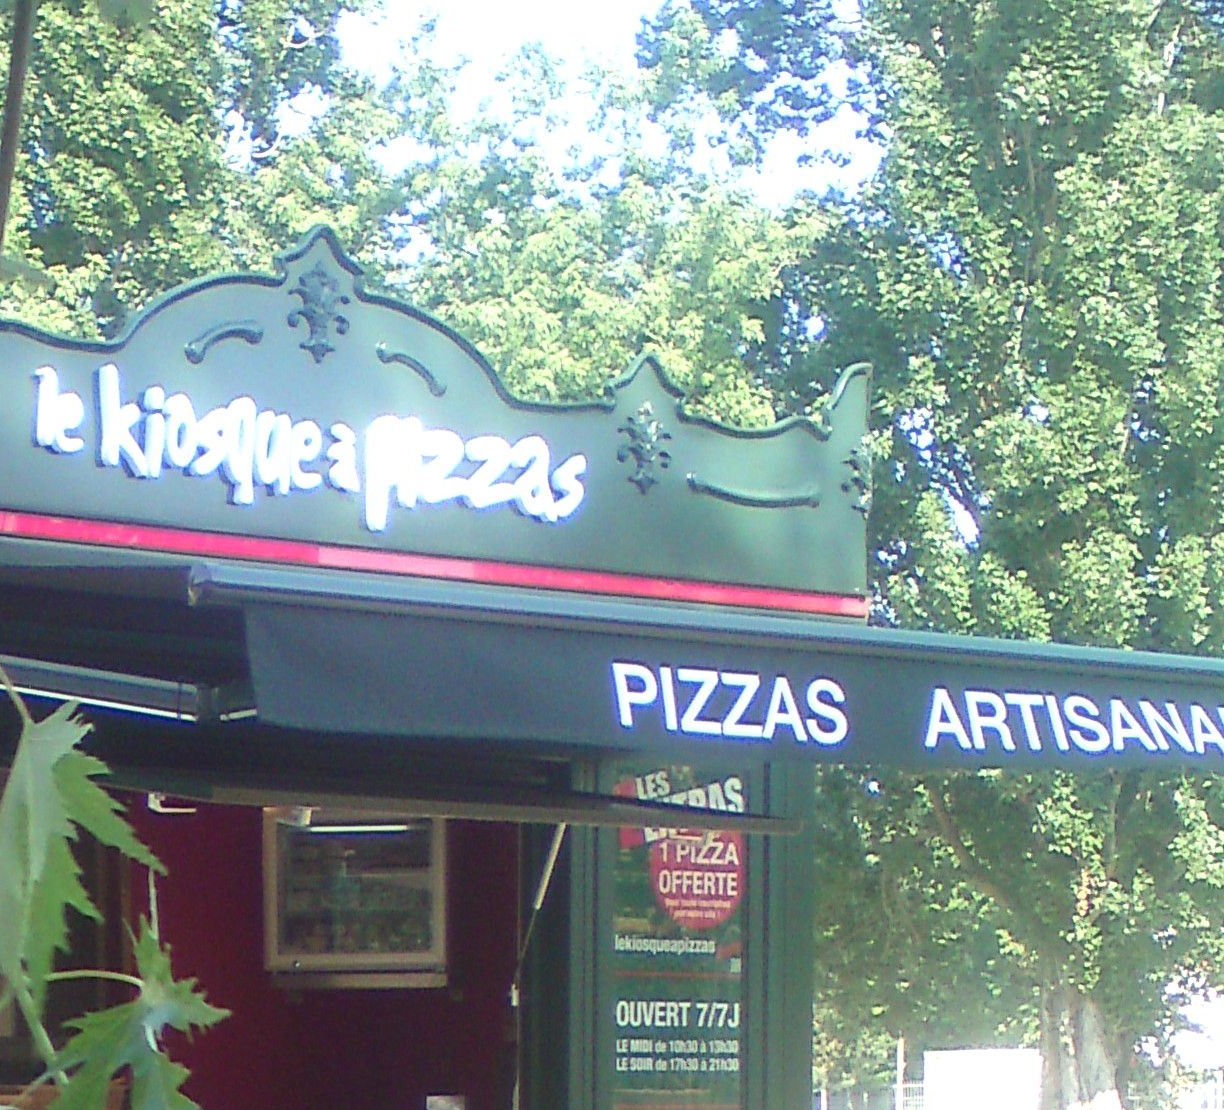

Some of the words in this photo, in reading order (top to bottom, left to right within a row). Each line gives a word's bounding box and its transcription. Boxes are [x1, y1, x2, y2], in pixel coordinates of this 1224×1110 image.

[94, 361, 324, 505] kiosque
[612, 662, 849, 745] PIZZAS
[925, 687, 1224, 755] ARTISANA
[636, 770, 671, 800] LES
[659, 842, 669, 863] 1
[676, 841, 739, 866] PIZZA
[659, 869, 738, 896] OFFERTE
[616, 1000, 691, 1028] OUVERT
[696, 1002, 740, 1029] 7/7J
[616, 1039, 629, 1053] LE
[616, 1057, 629, 1072] LE
[630, 1057, 653, 1072] SOIR
